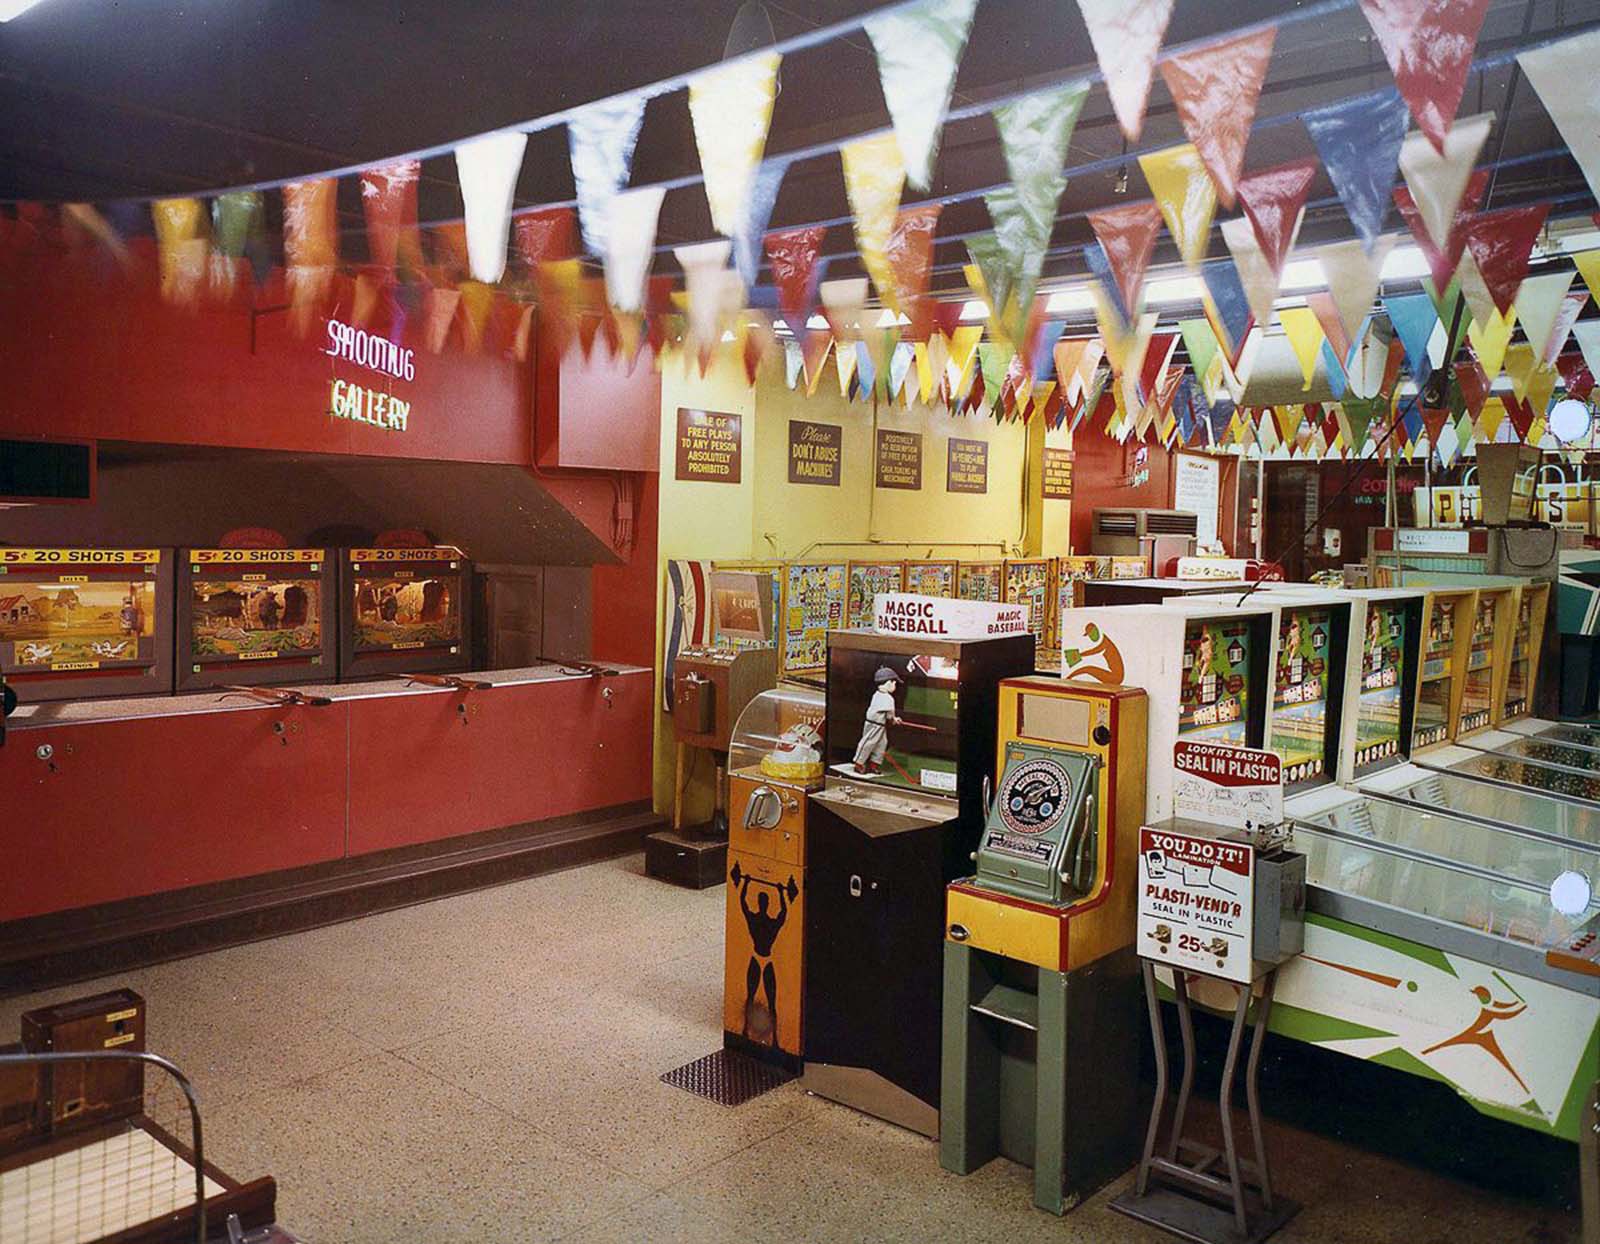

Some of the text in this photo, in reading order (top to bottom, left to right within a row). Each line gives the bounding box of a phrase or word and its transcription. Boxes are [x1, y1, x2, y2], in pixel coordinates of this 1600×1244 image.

[332, 380, 410, 431] GALLERY
[715, 417, 728, 428] OF
[687, 427, 733, 440] FREE PLAYS
[681, 437, 737, 452] TO ANY PERSON
[792, 442, 838, 462] DON'T ABUSE
[687, 450, 731, 463] ABSOLUTELY
[688, 462, 730, 475] PROHIBITED
[796, 461, 833, 478] MACHINES
[4, 551, 155, 562] 5¢ 20 SHOTS 5¢
[222, 551, 244, 561] 20
[250, 551, 295, 561] SHOTS
[376, 551, 395, 560] 20
[399, 550, 437, 560] SHOTS
[885, 600, 934, 618] MAGIC
[996, 610, 1021, 622] MAGIC
[878, 615, 949, 634] BASEBALL
[987, 621, 1026, 634] BASEBALL
[1187, 744, 1267, 763] LOOK IT'S EASY!
[1176, 752, 1279, 782] SEAL IN PLASTIC
[1151, 834, 1244, 864] YOU DO IT!
[1172, 852, 1222, 866] LAMINATION
[1146, 885, 1242, 918] PLASTI-VEND'R
[1152, 902, 1234, 929] SEAL IN PLASTIC
